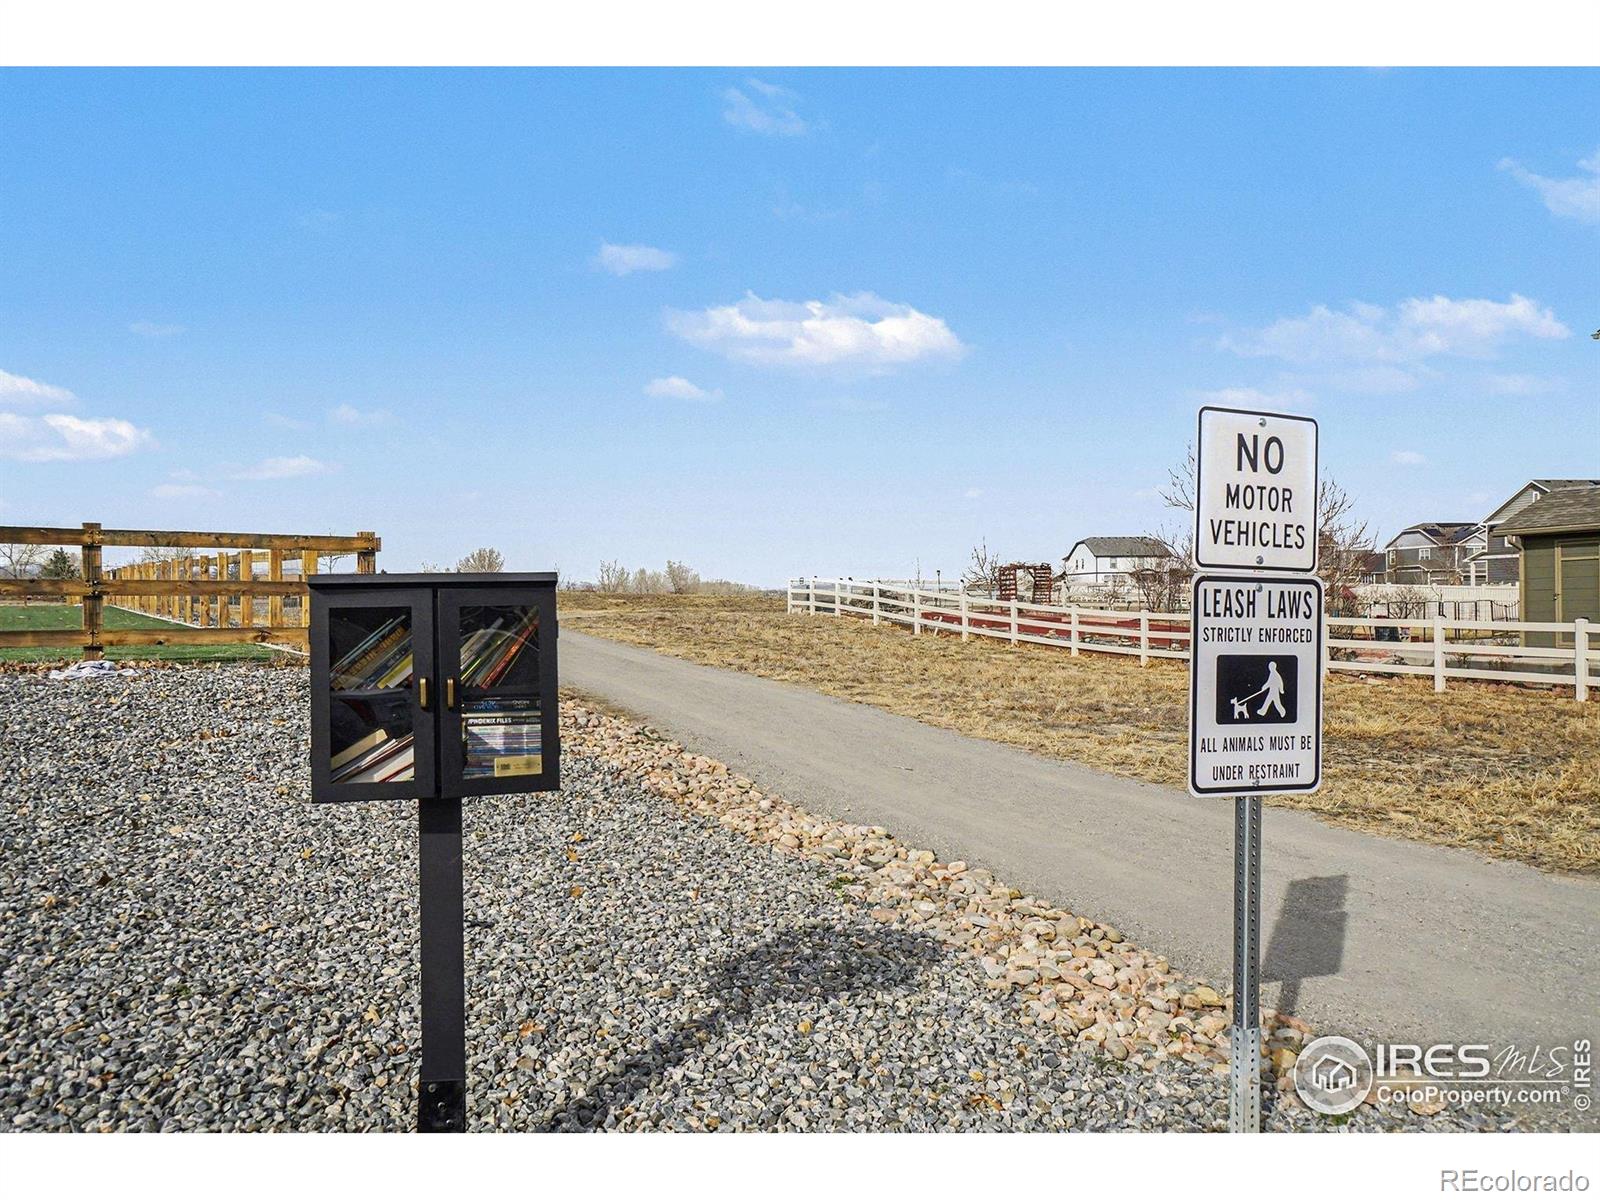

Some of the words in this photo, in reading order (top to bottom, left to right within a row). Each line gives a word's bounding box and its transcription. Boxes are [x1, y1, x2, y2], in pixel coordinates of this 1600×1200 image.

[1237, 433, 1284, 474] NO
[1226, 484, 1292, 513] MOTOR
[1210, 519, 1305, 549] VEHICLES
[1203, 588, 1256, 618] LEASH
[1267, 590, 1313, 620] LAWS
[1203, 627, 1253, 643] STRICTLY
[1259, 628, 1312, 643] ENFORCED
[1200, 737, 1217, 753] ALL
[1222, 736, 1264, 752] ANIMALS
[1269, 735, 1295, 751] MUST
[1301, 735, 1312, 750] BE
[1212, 765, 1244, 781] UNDER
[1249, 763, 1300, 780] RESTRAINT
